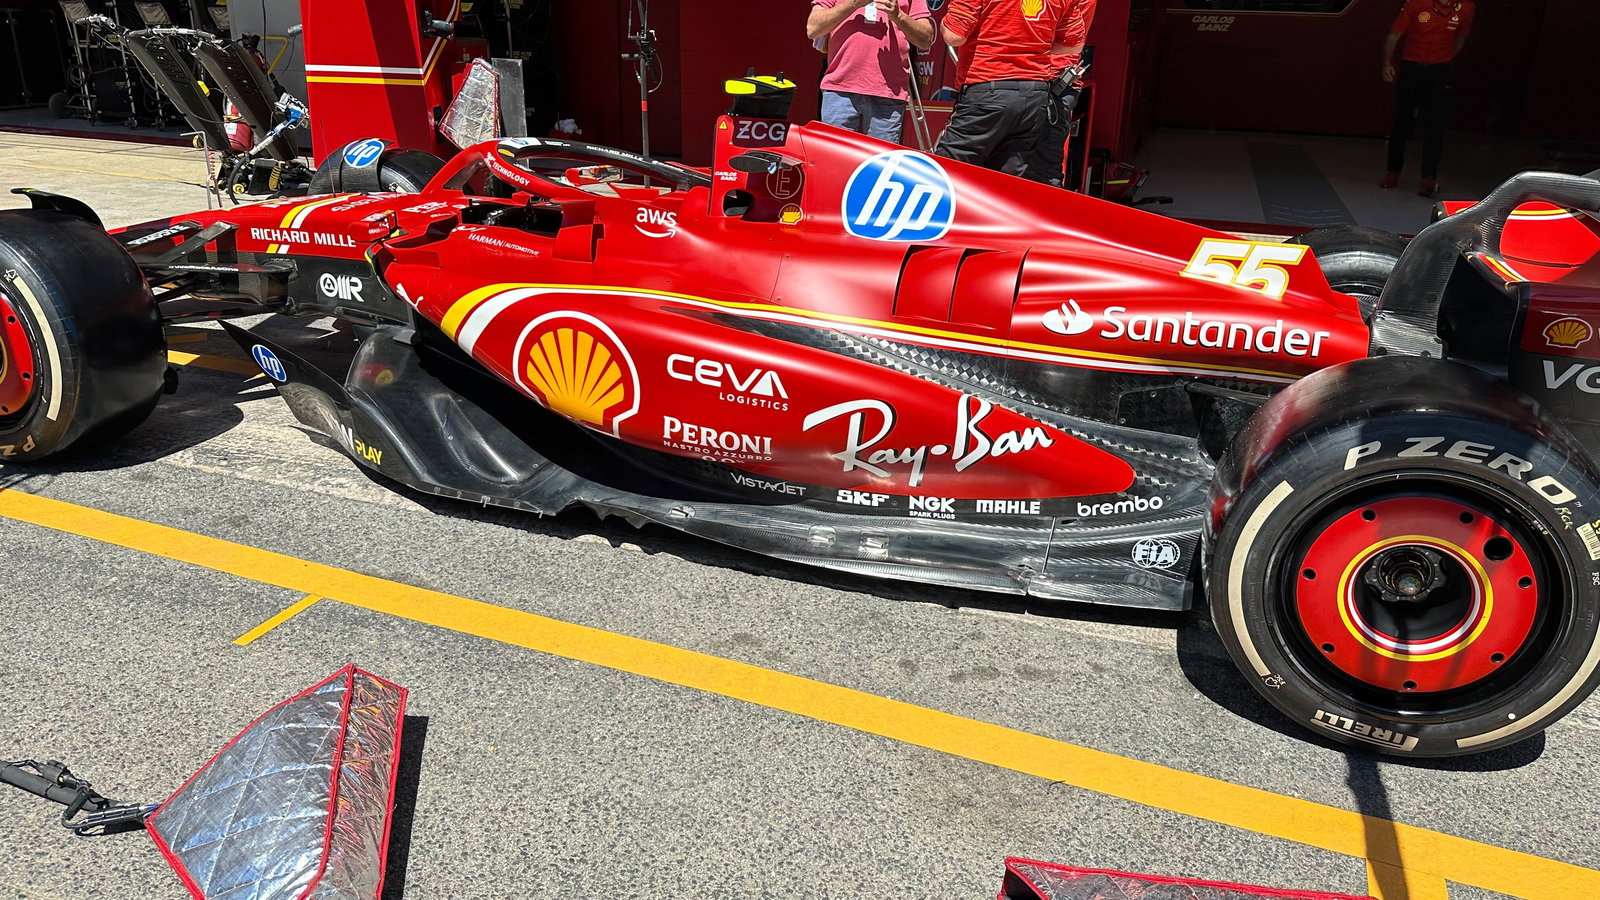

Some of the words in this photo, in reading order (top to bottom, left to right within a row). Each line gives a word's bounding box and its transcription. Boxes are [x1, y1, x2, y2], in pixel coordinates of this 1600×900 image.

[1191, 15, 1235, 24] CARLOS
[1197, 23, 1231, 32] SAINZ
[345, 140, 381, 167] hp
[492, 161, 531, 187] TECHNOLOGY
[855, 157, 945, 240] hp
[636, 207, 677, 227] aws
[250, 227, 310, 244] RICHARD
[313, 232, 357, 248] MILLE
[468, 233, 503, 248] HARMAN
[505, 242, 540, 256] AUTOMOTIVE
[1178, 237, 1310, 302] 55
[1100, 305, 1331, 358] Santander
[258, 345, 282, 382] hp
[719, 392, 789, 412] LOGISTICS
[22, 434, 37, 453] P
[662, 415, 773, 456] PERONI
[354, 439, 383, 465] PLAY
[662, 440, 711, 455] NASTRO
[714, 450, 773, 461] AZZURRO
[1343, 440, 1382, 471] P
[1397, 436, 1577, 505] ZERO
[836, 489, 890, 507] SKF
[908, 495, 956, 513] NGK
[975, 499, 1041, 515] MAHLE
[1077, 495, 1164, 517] brembo
[908, 510, 931, 518] SPARK
[932, 512, 956, 520] PLUGS
[1133, 543, 1176, 563] FIA
[1591, 571, 1600, 586] FSC
[1310, 709, 1420, 752] PIRELLI
